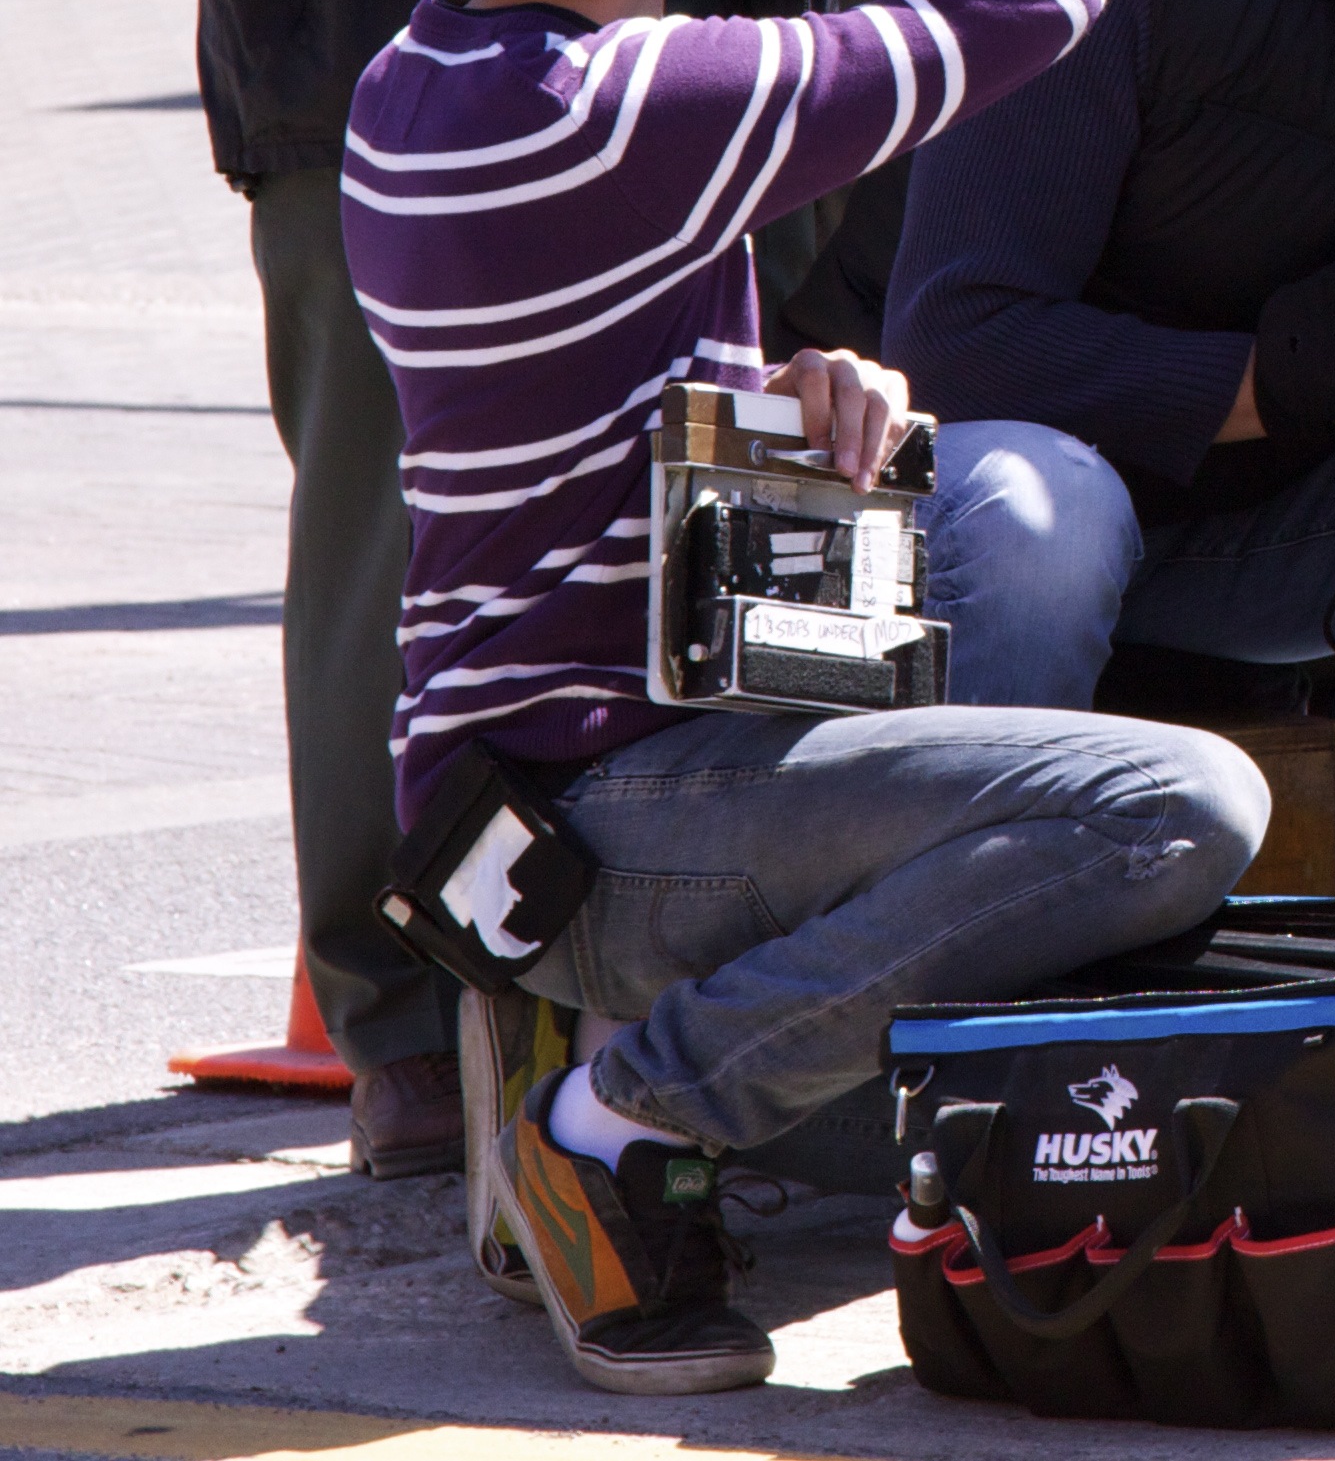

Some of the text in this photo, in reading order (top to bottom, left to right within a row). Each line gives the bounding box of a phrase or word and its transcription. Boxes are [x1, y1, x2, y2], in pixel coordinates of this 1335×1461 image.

[1034, 1128, 1158, 1166] HUSKY
[1033, 1167, 1048, 1182] The
[1049, 1166, 1089, 1184] Toughest
